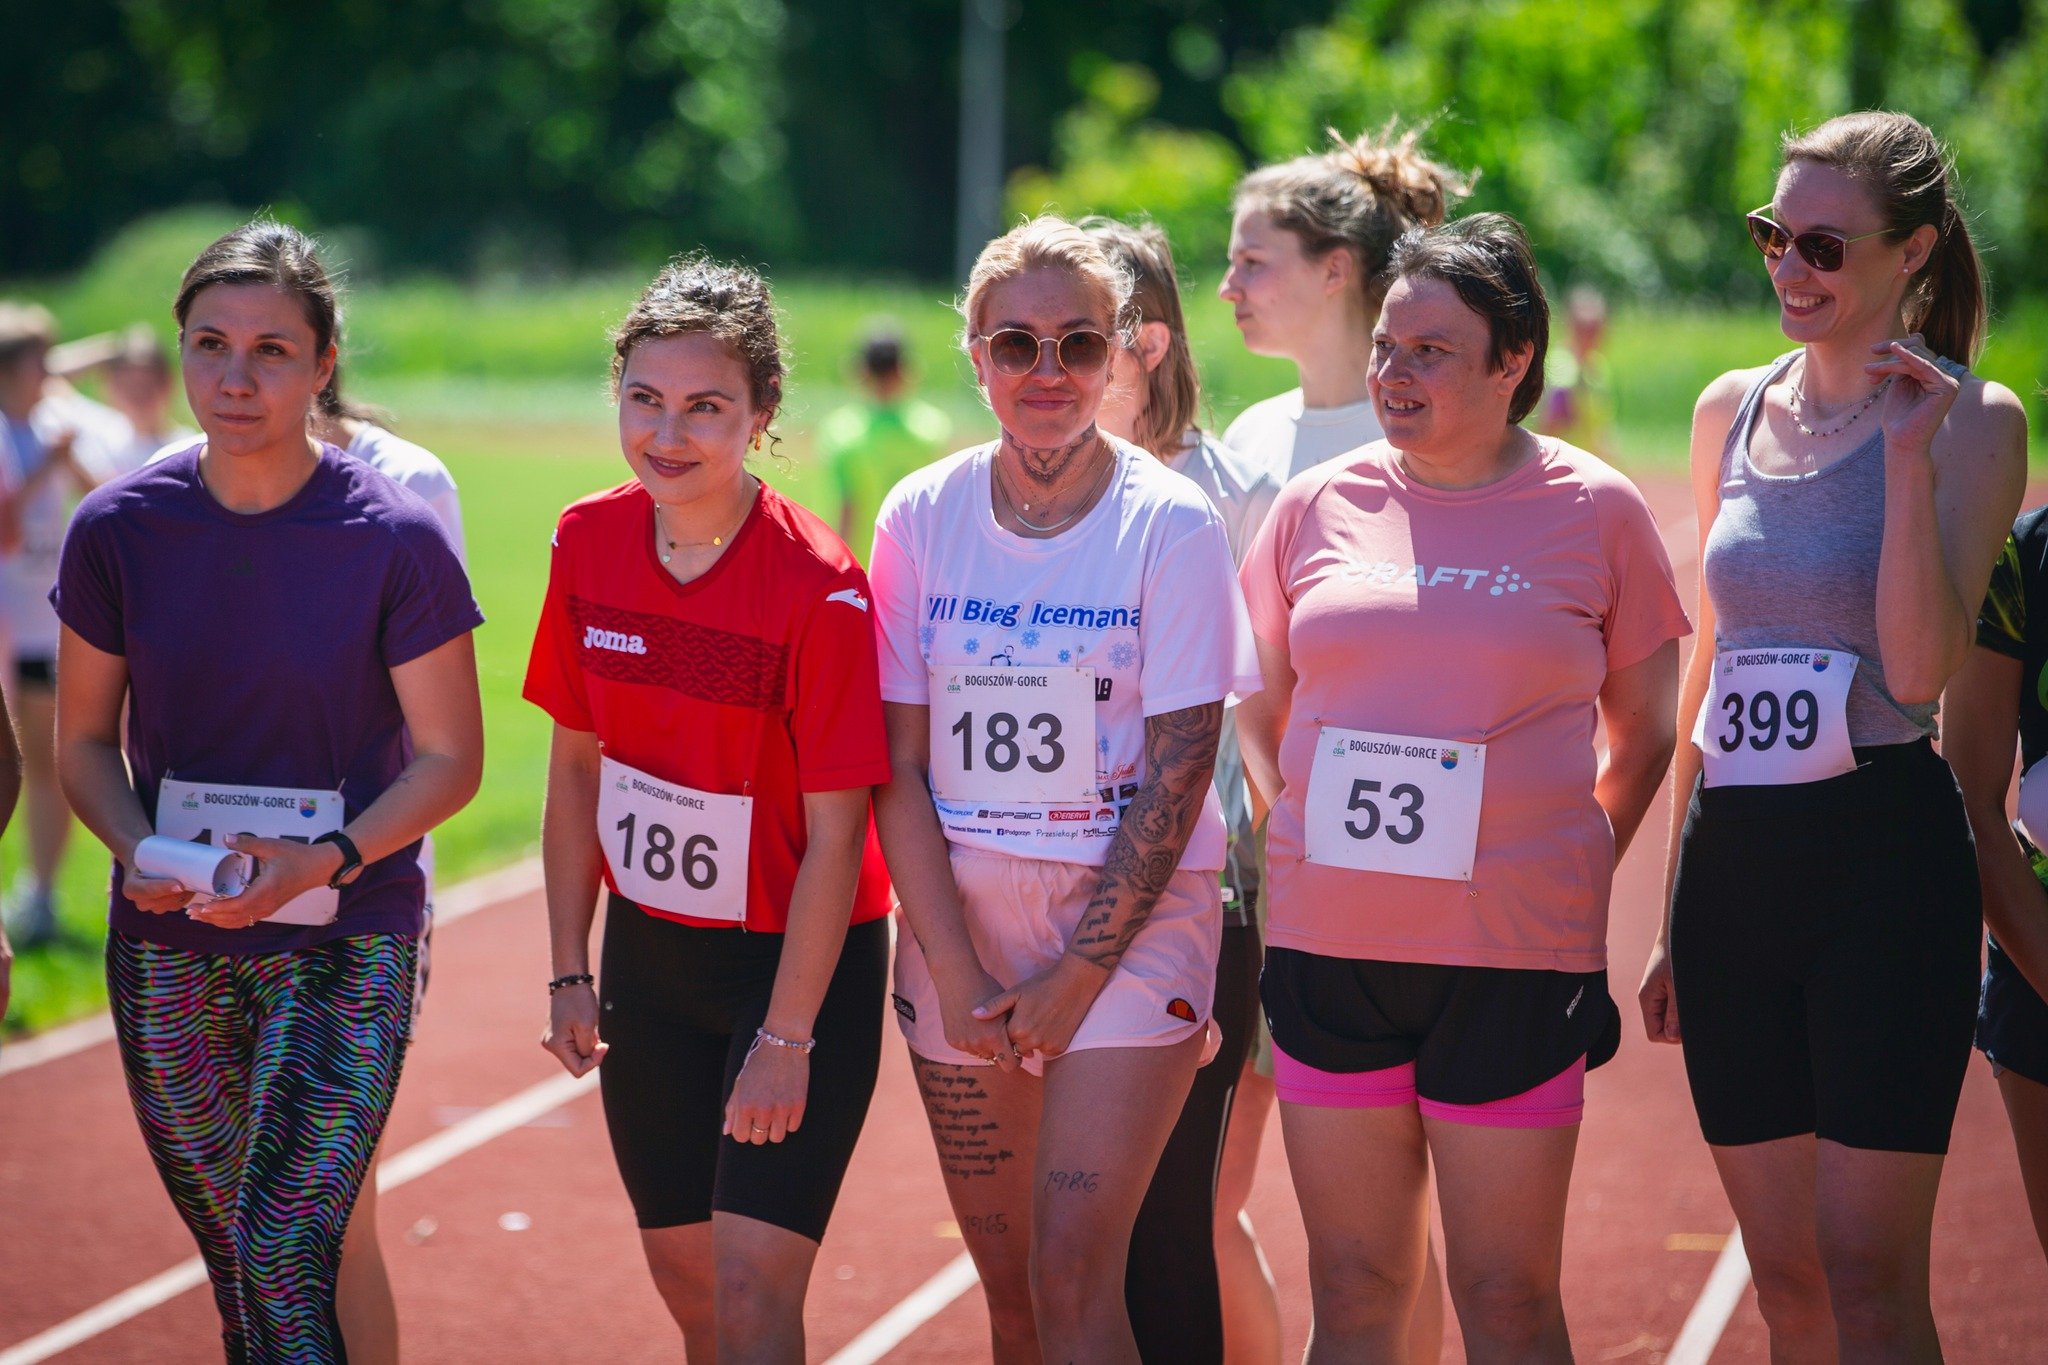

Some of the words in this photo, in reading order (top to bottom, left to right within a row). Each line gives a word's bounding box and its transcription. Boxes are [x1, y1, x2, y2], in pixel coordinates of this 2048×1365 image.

[963, 599, 1020, 627] Bieg
[1736, 652, 1811, 667] BOGUSZÓW-GORCE
[965, 673, 1048, 688] BOGUSZÓW-GORCE
[1718, 689, 1819, 753] 399
[952, 711, 1066, 773] 183
[1350, 739, 1437, 760] BOGUSZÓW-GORCE
[204, 792, 296, 809] BOGUSZÓW-GORCE
[632, 778, 705, 811] BOGUSZÓW-GORCE
[1061, 812, 1090, 820] ENERVIT
[1344, 778, 1425, 845] 53
[617, 812, 719, 891] 186
[1044, 1170, 1099, 1193] 1986
[964, 1213, 1008, 1235] 1965
